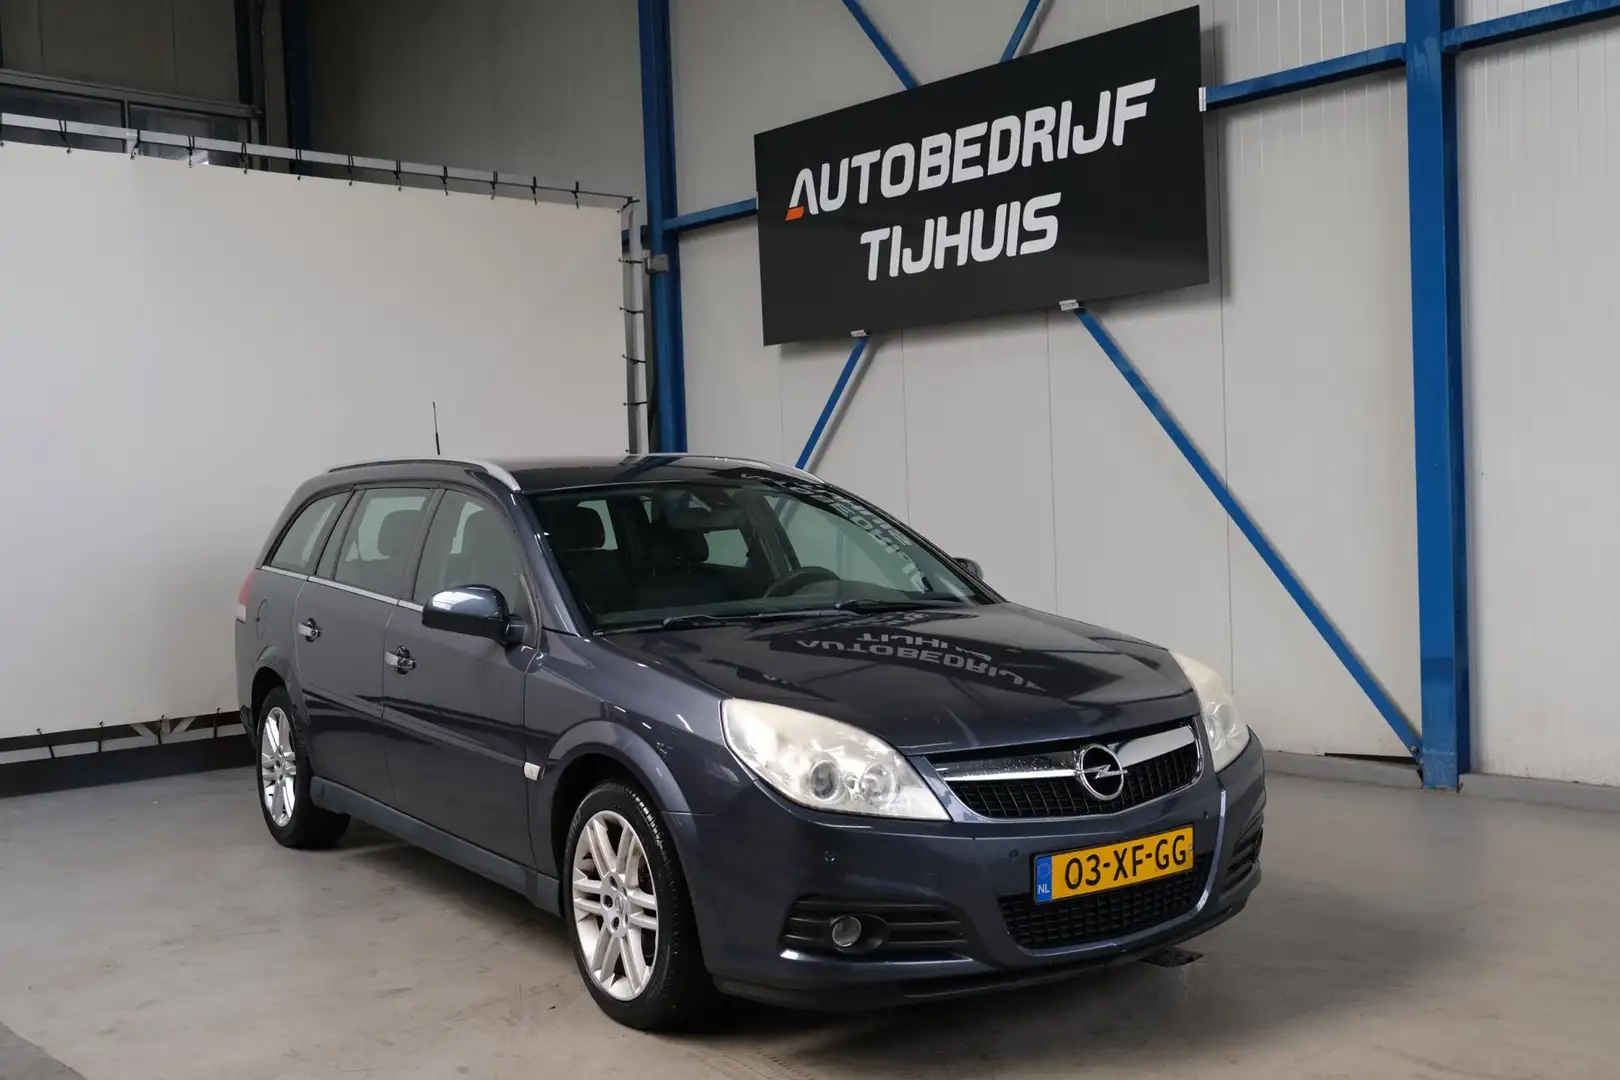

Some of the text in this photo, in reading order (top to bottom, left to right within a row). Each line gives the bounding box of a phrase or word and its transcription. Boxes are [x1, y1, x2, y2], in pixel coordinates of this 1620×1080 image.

[787, 78, 1156, 220] AUTOBEDRIJF
[860, 192, 1062, 281] TIJHUIS
[1037, 884, 1050, 894] NL
[1064, 835, 1186, 890] 03-XF-GG
